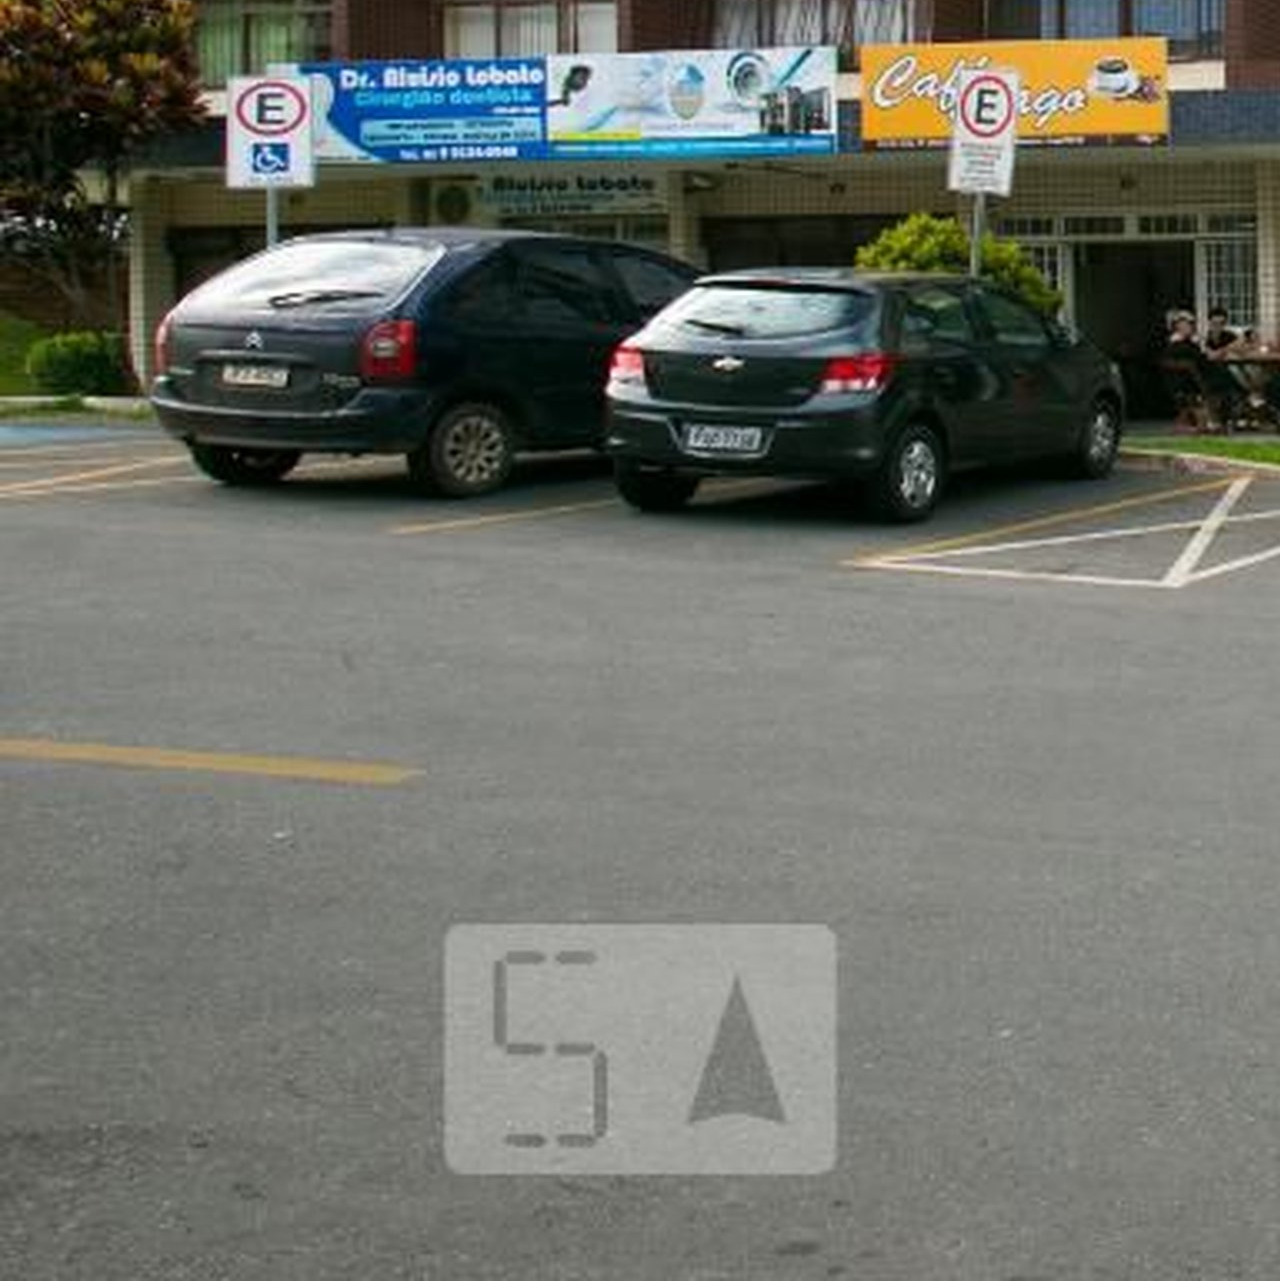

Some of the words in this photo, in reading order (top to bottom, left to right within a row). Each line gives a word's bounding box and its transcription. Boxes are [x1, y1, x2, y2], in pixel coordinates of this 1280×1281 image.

[340, 69, 376, 89] Dr.
[256, 92, 285, 125] E
[974, 88, 999, 125] E
